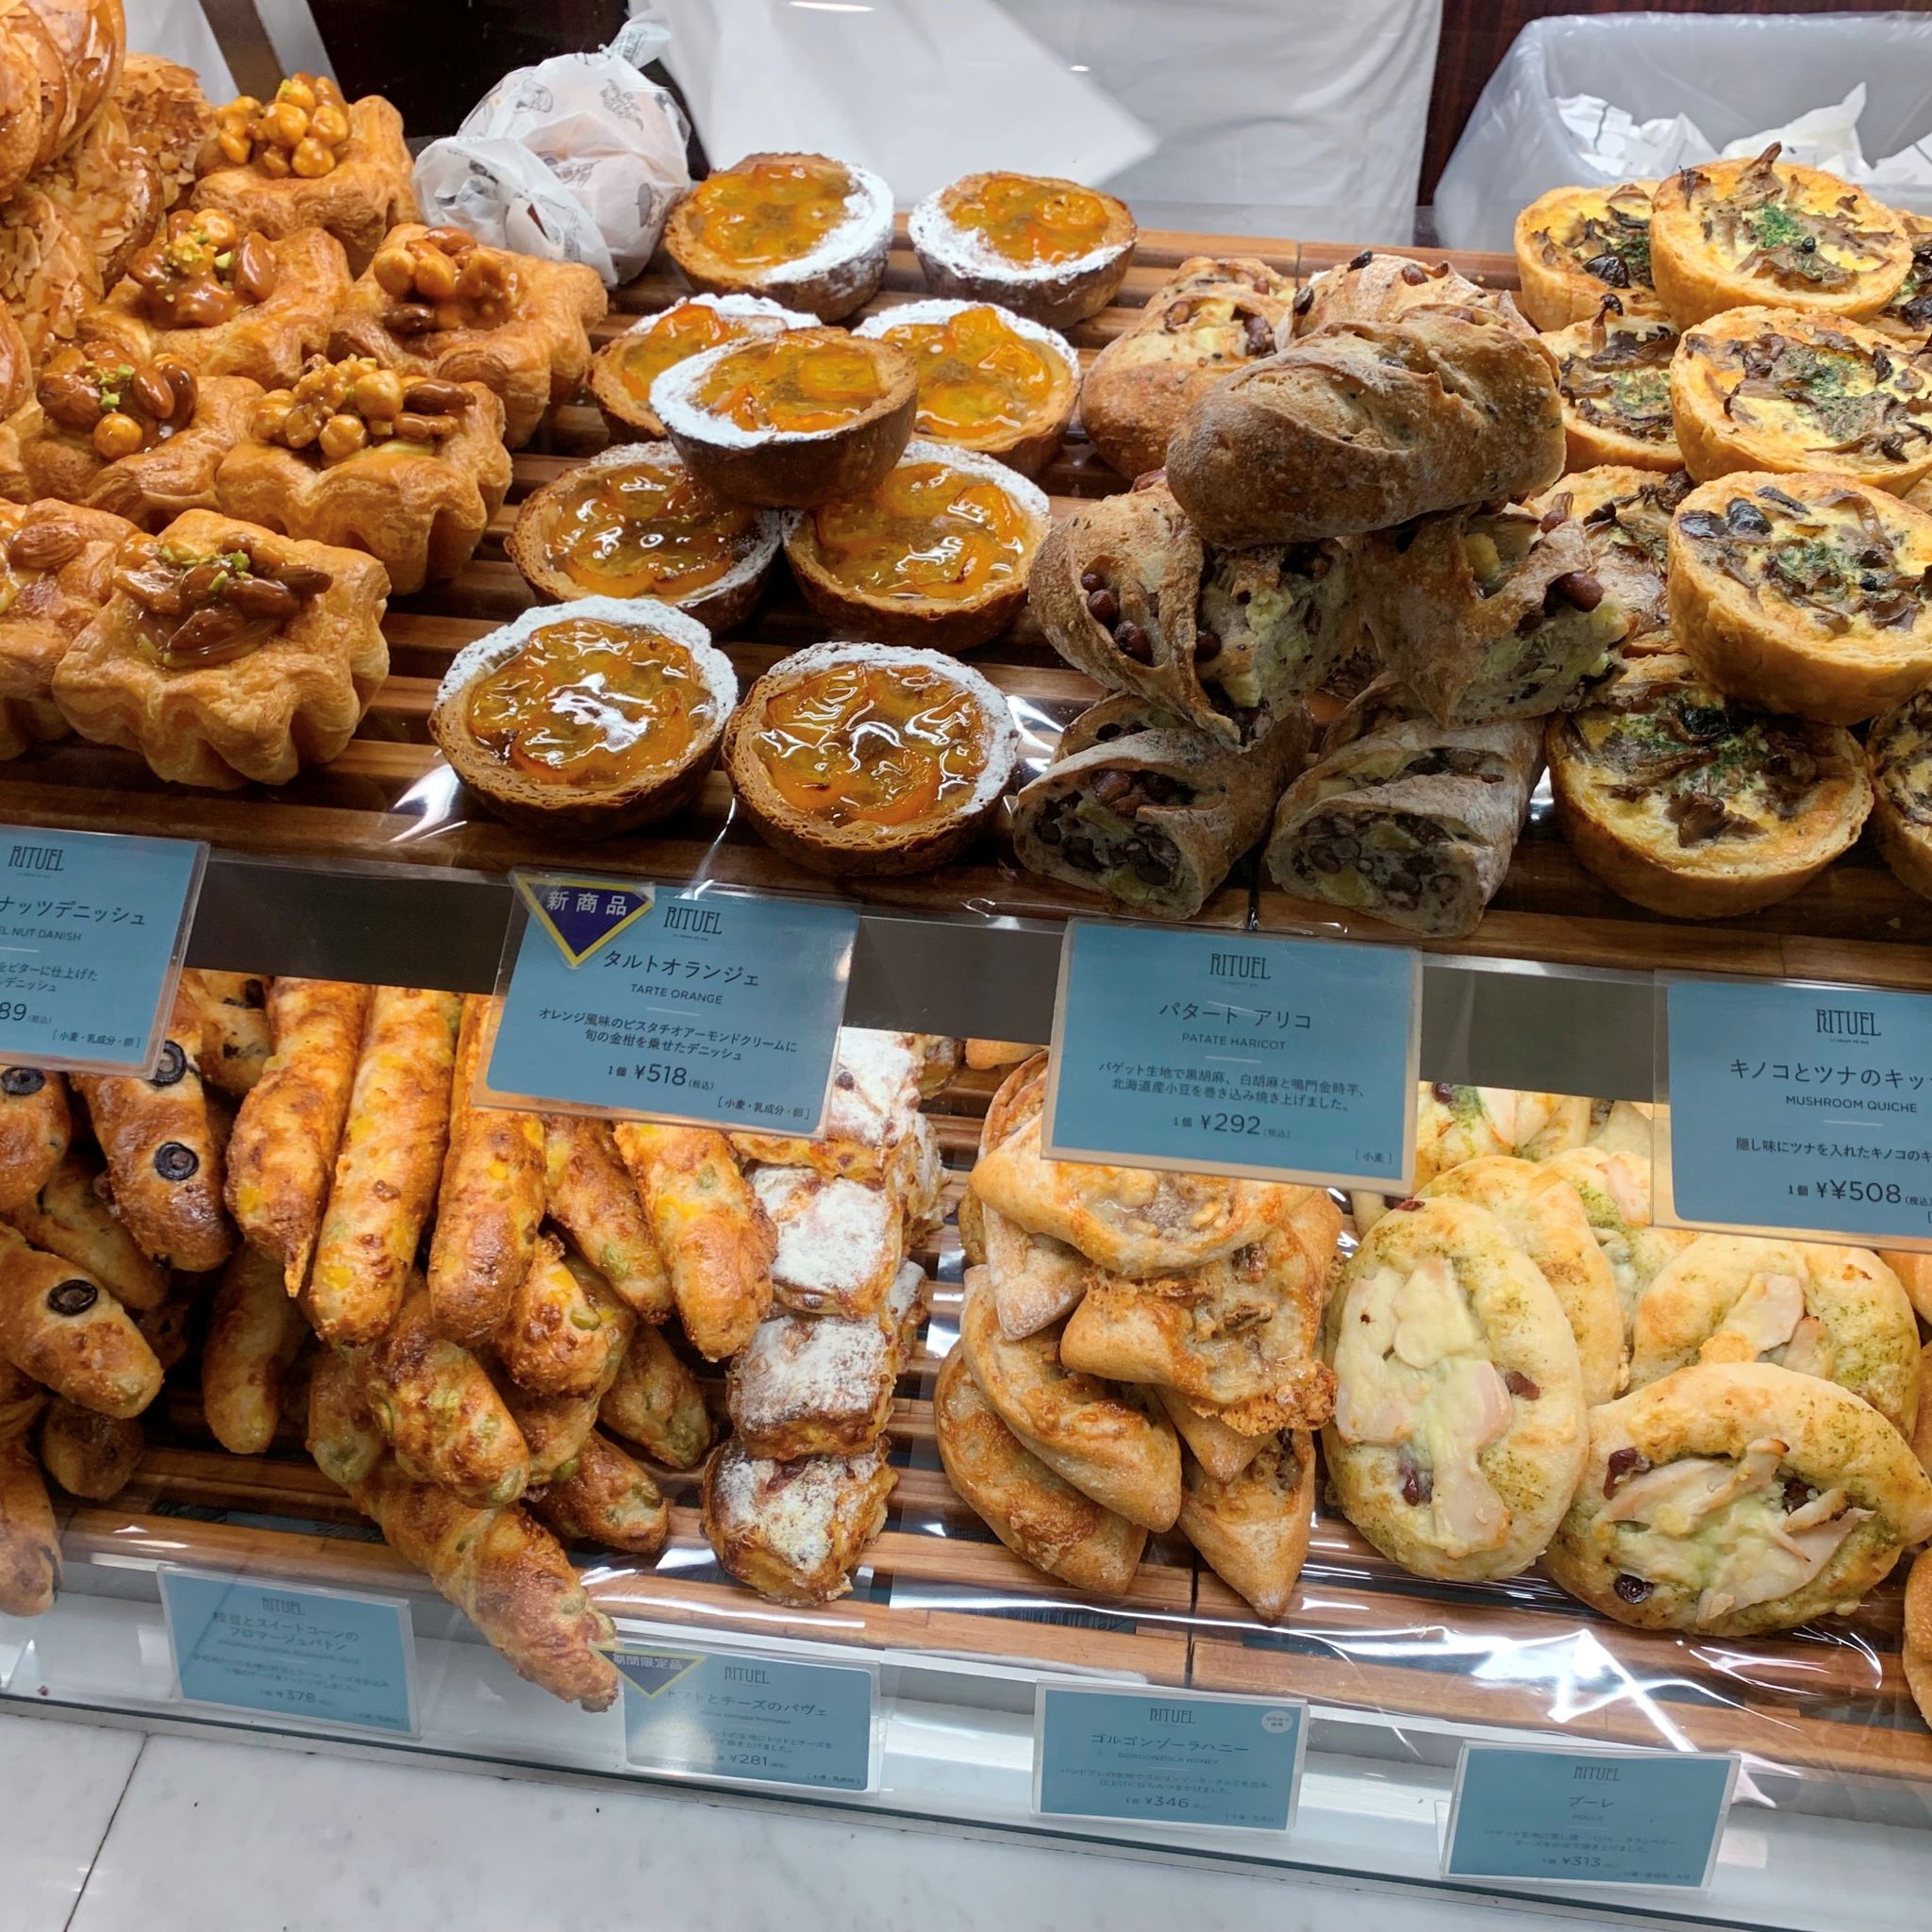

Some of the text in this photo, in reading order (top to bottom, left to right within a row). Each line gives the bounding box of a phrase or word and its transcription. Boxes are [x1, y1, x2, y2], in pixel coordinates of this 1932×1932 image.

[8, 845, 64, 872] RITUEL
[0, 896, 146, 925] ナッツデニッシュ
[547, 891, 627, 916] 新商品
[663, 906, 723, 935] RITUEL
[12, 927, 36, 937] NUT
[38, 929, 82, 941] DANISH
[603, 950, 759, 987] タルトオランジェ
[1209, 953, 1271, 980] RITUEL
[0, 976, 57, 991] デニッシュ
[630, 984, 723, 1005] TARTE ORANGE
[1158, 1001, 1311, 1030] パタート アリコ
[1816, 1008, 1882, 1036] RITUEL
[539, 1008, 798, 1054] オレンジ風味のピスタチオアーモンドクリームに
[1182, 1032, 1286, 1050] PATATE HARICOT
[585, 1030, 742, 1060] 旬の金柑を乗せたデニッシュ
[1730, 1058, 1932, 1091] キノコとツナのキッ
[1786, 1095, 1918, 1113] MUSHROOM QUICHE
[724, 1666, 770, 1685] RITUEL
[1149, 1707, 1196, 1724] RITUEL
[1091, 1733, 1249, 1753] ゴルゴンゾーラハニー
[1573, 1766, 1621, 1781] RITUEL
